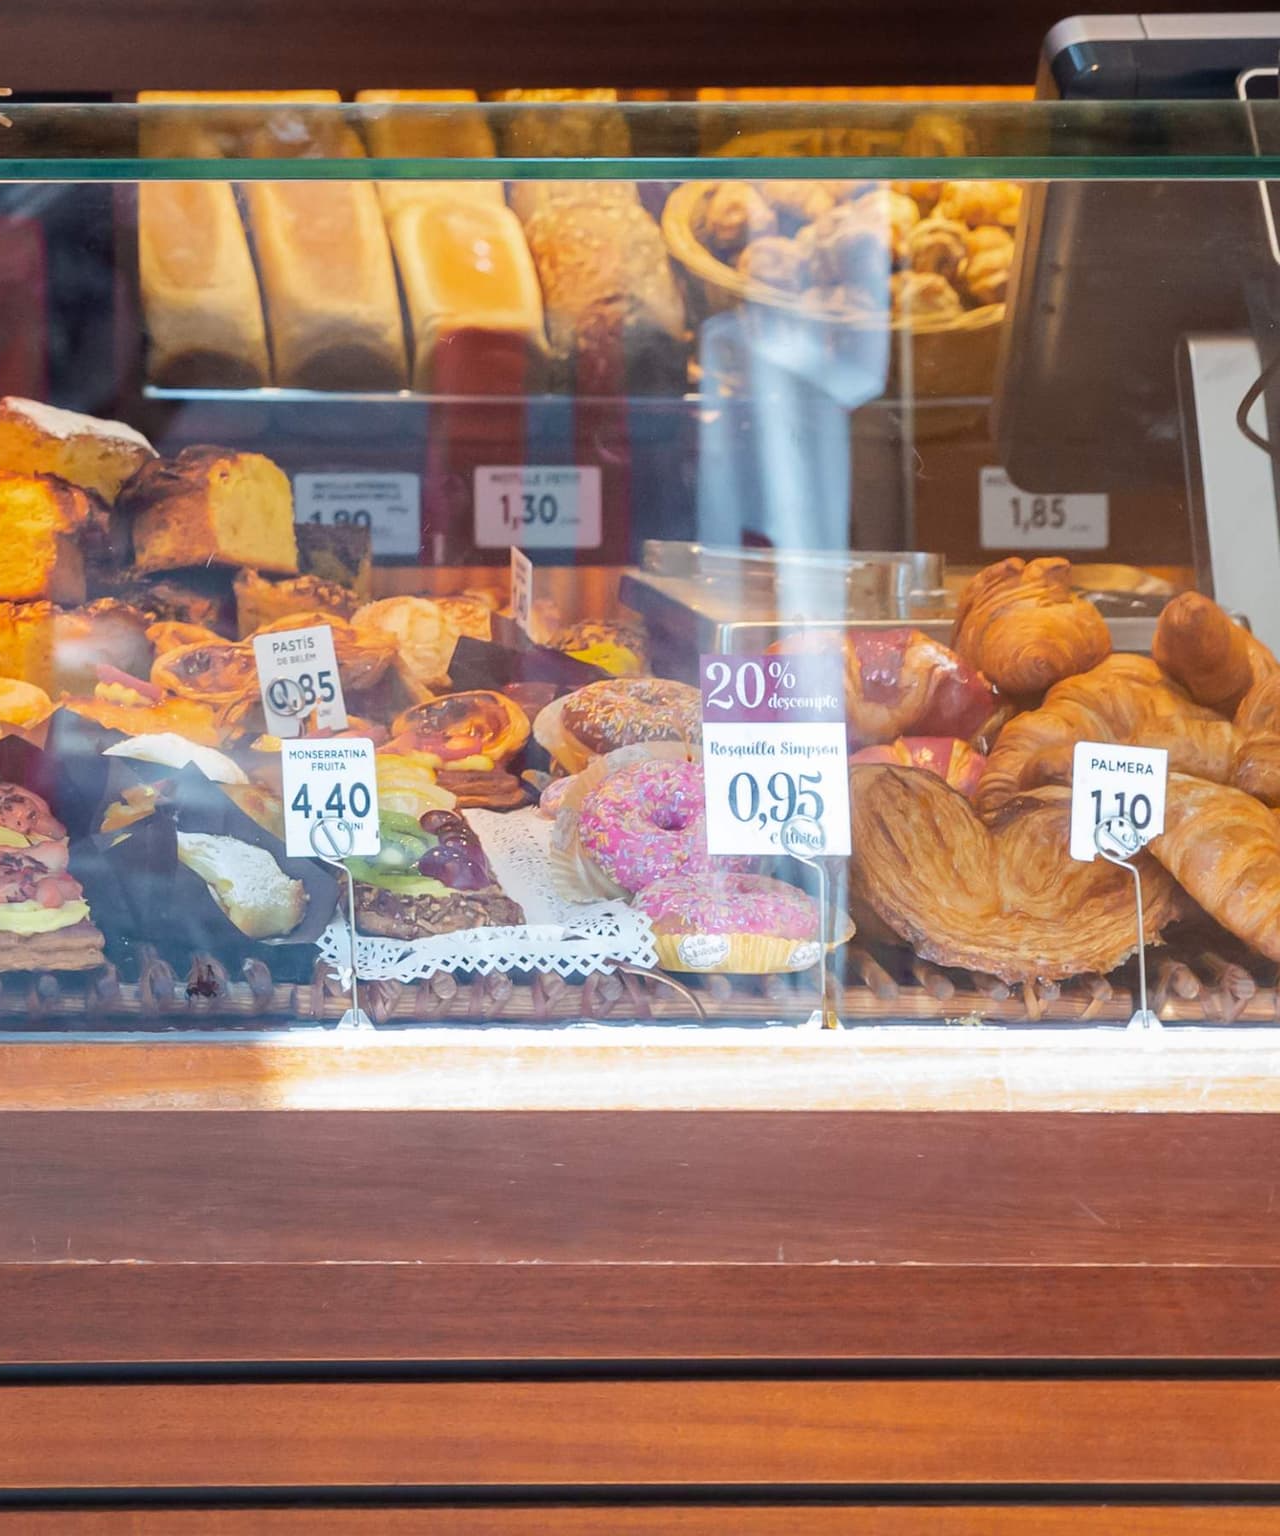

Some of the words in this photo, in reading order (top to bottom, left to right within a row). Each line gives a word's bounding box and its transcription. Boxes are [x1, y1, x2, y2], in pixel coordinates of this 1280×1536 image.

[501, 493, 557, 530] 1,30
[1009, 496, 1066, 535] 1,85
[272, 635, 315, 653] PASTÍS
[705, 661, 796, 711] 20%
[768, 693, 838, 712] descompte
[289, 749, 367, 759] MONSERRATINA
[710, 741, 776, 756] Rosquilla
[780, 741, 838, 758] Simpson
[311, 763, 346, 771] FRUITA
[1091, 758, 1154, 775] PALMERA
[728, 771, 825, 830] 0,95
[1091, 789, 1152, 833] 1,10
